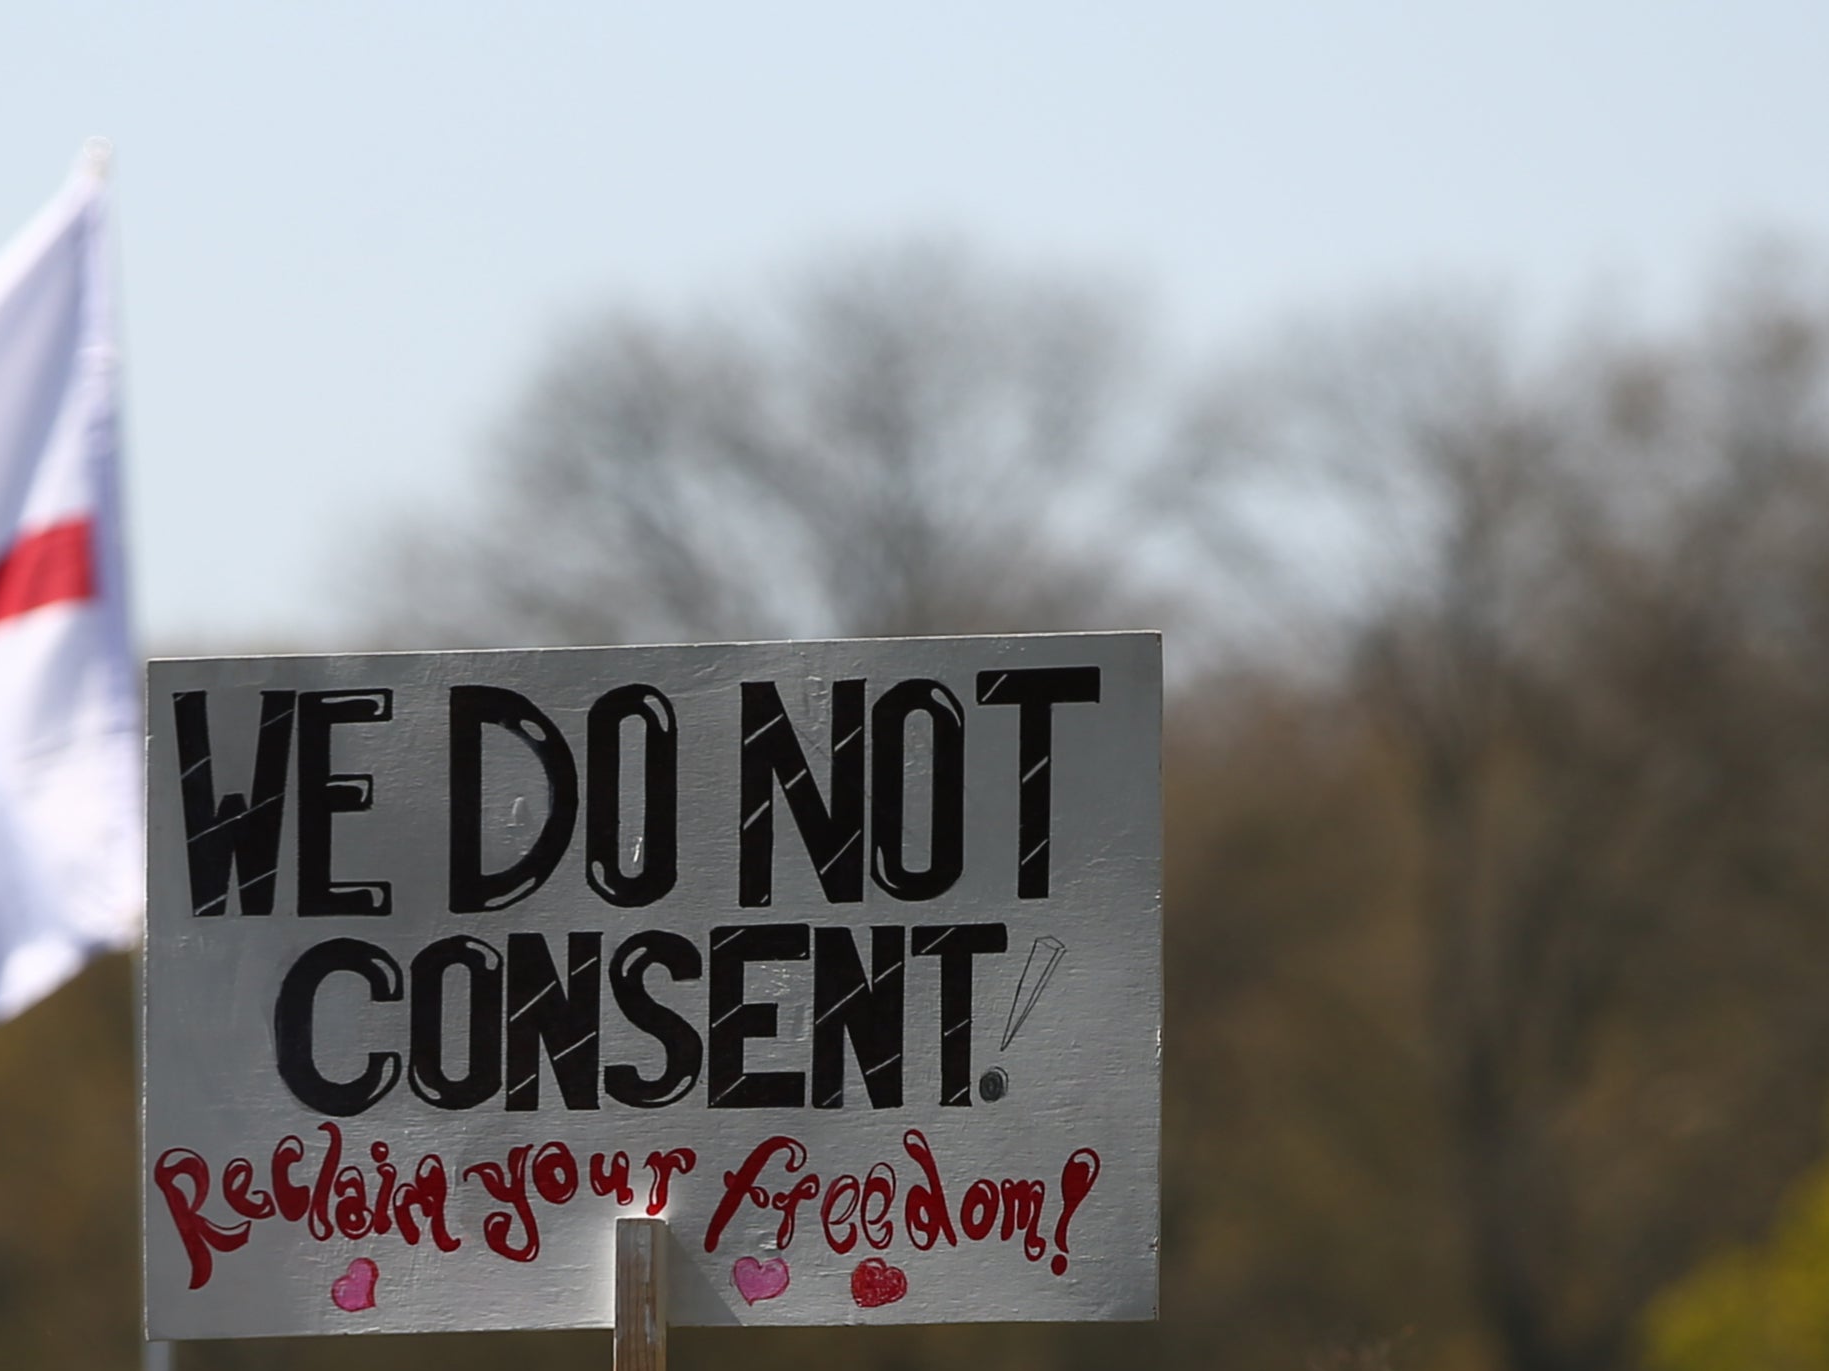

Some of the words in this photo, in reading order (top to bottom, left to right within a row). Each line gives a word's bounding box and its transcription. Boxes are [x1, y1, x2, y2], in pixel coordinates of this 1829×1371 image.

[172, 688, 393, 918] WE
[449, 683, 678, 914] DO
[740, 666, 1101, 909] NOT
[274, 922, 1066, 1117] CONSENT!
[464, 1140, 697, 1263] your
[703, 1128, 1101, 1276] freedom!
